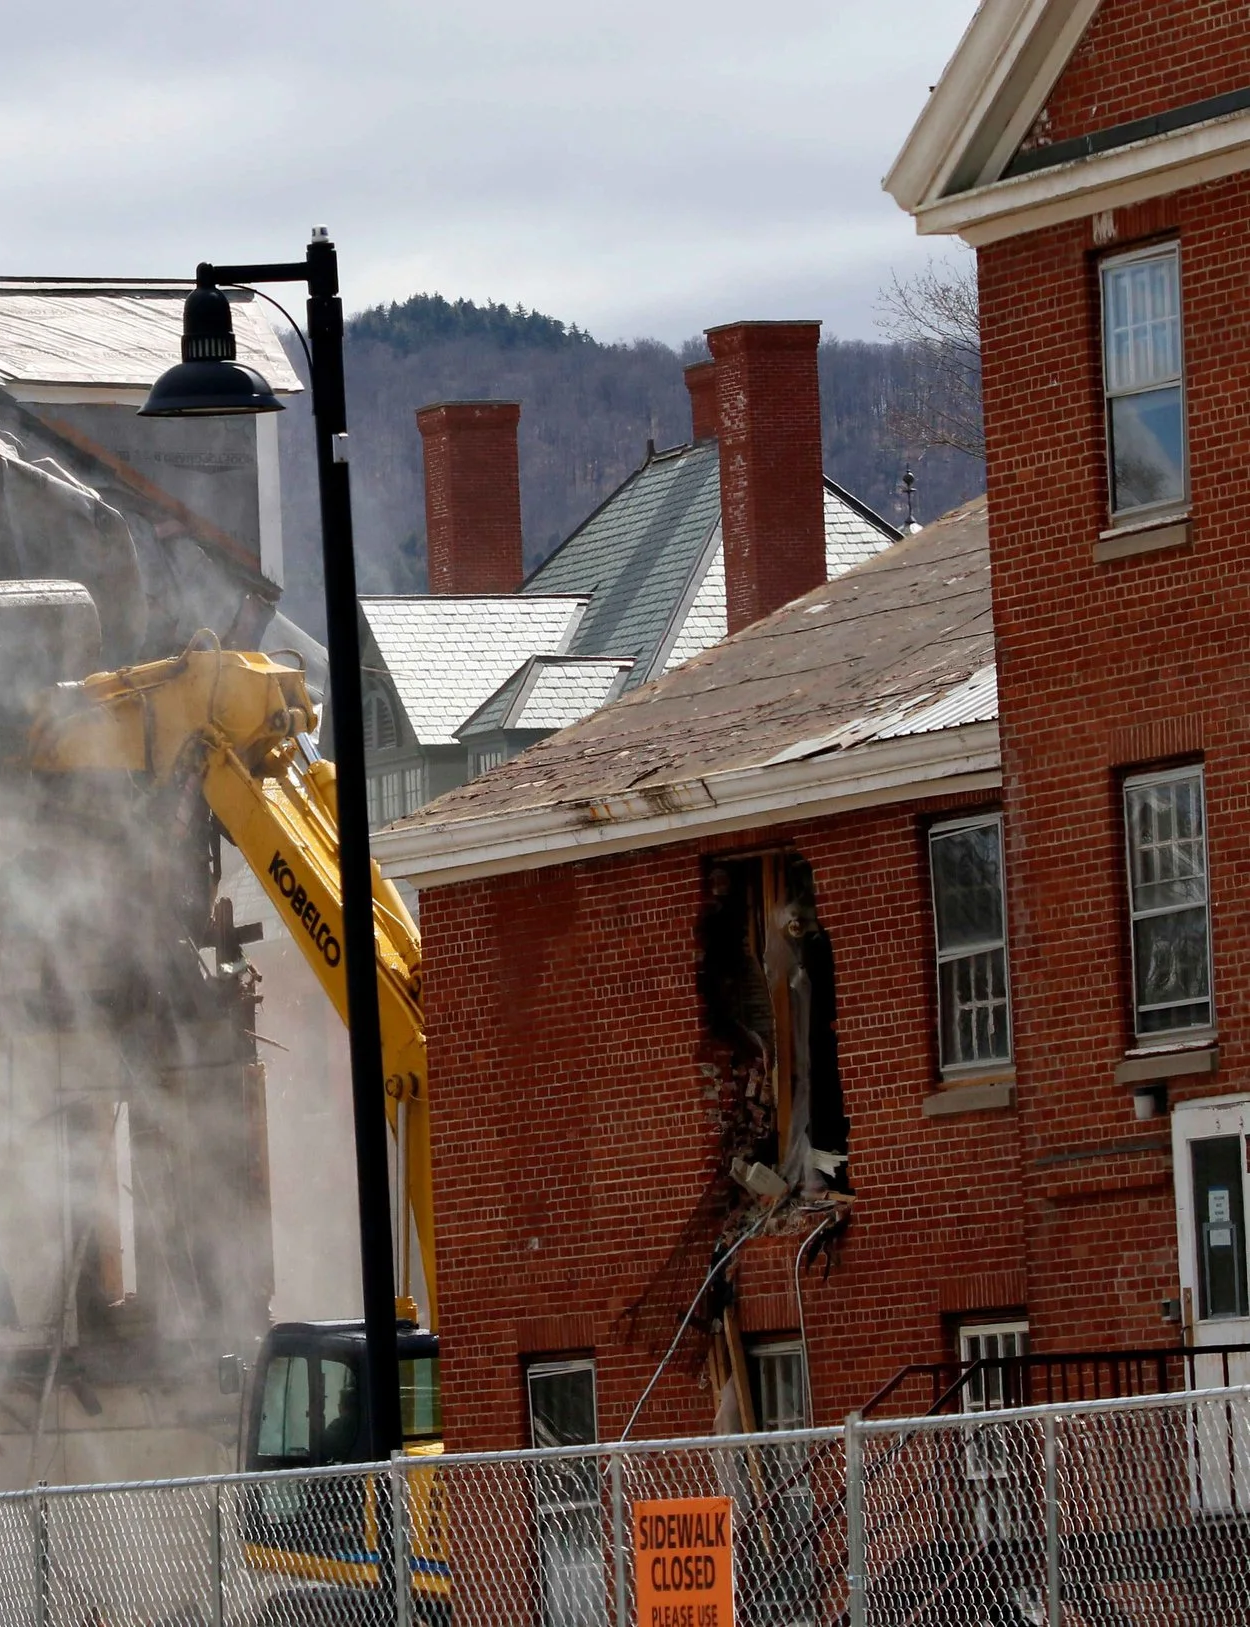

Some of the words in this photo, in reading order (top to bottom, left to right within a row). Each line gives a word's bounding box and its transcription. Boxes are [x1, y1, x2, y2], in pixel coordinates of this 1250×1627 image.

[268, 849, 341, 968] KOBELCO
[639, 1512, 726, 1550] SIDEWALK
[651, 1555, 715, 1592] CLOSED
[651, 1605, 694, 1627] PLEASE
[697, 1604, 718, 1627] USE
